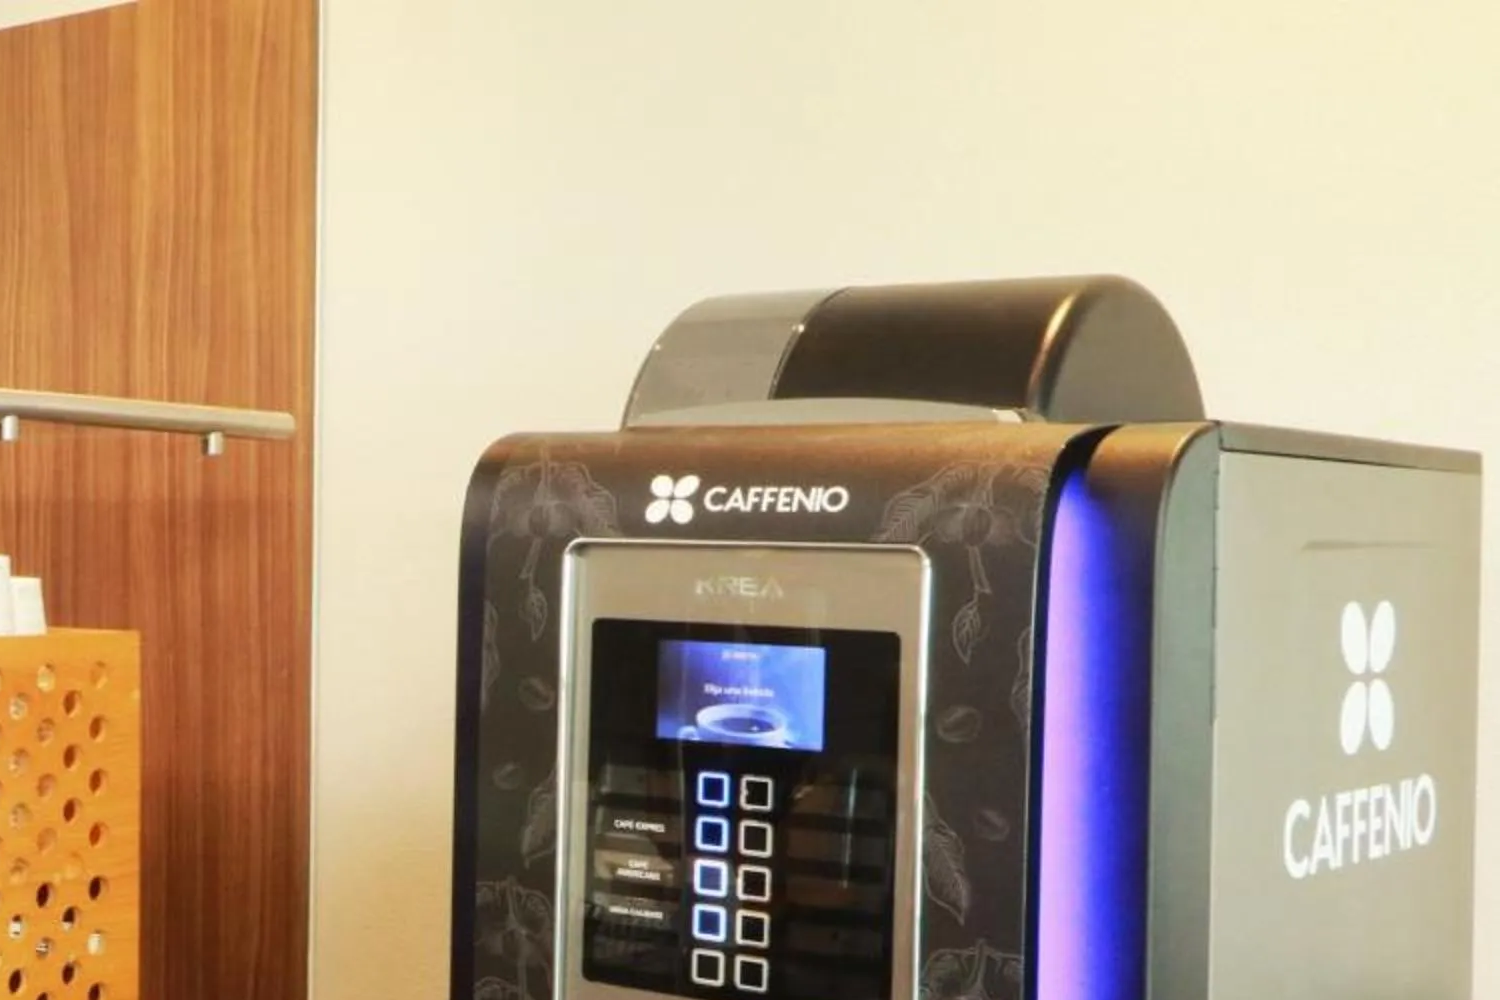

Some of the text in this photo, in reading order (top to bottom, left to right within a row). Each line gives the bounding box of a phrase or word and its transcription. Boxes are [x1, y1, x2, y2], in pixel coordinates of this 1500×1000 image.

[703, 486, 849, 513] CAFFENIO
[695, 576, 784, 599] KREA
[1283, 773, 1436, 879] CAFFENIO
